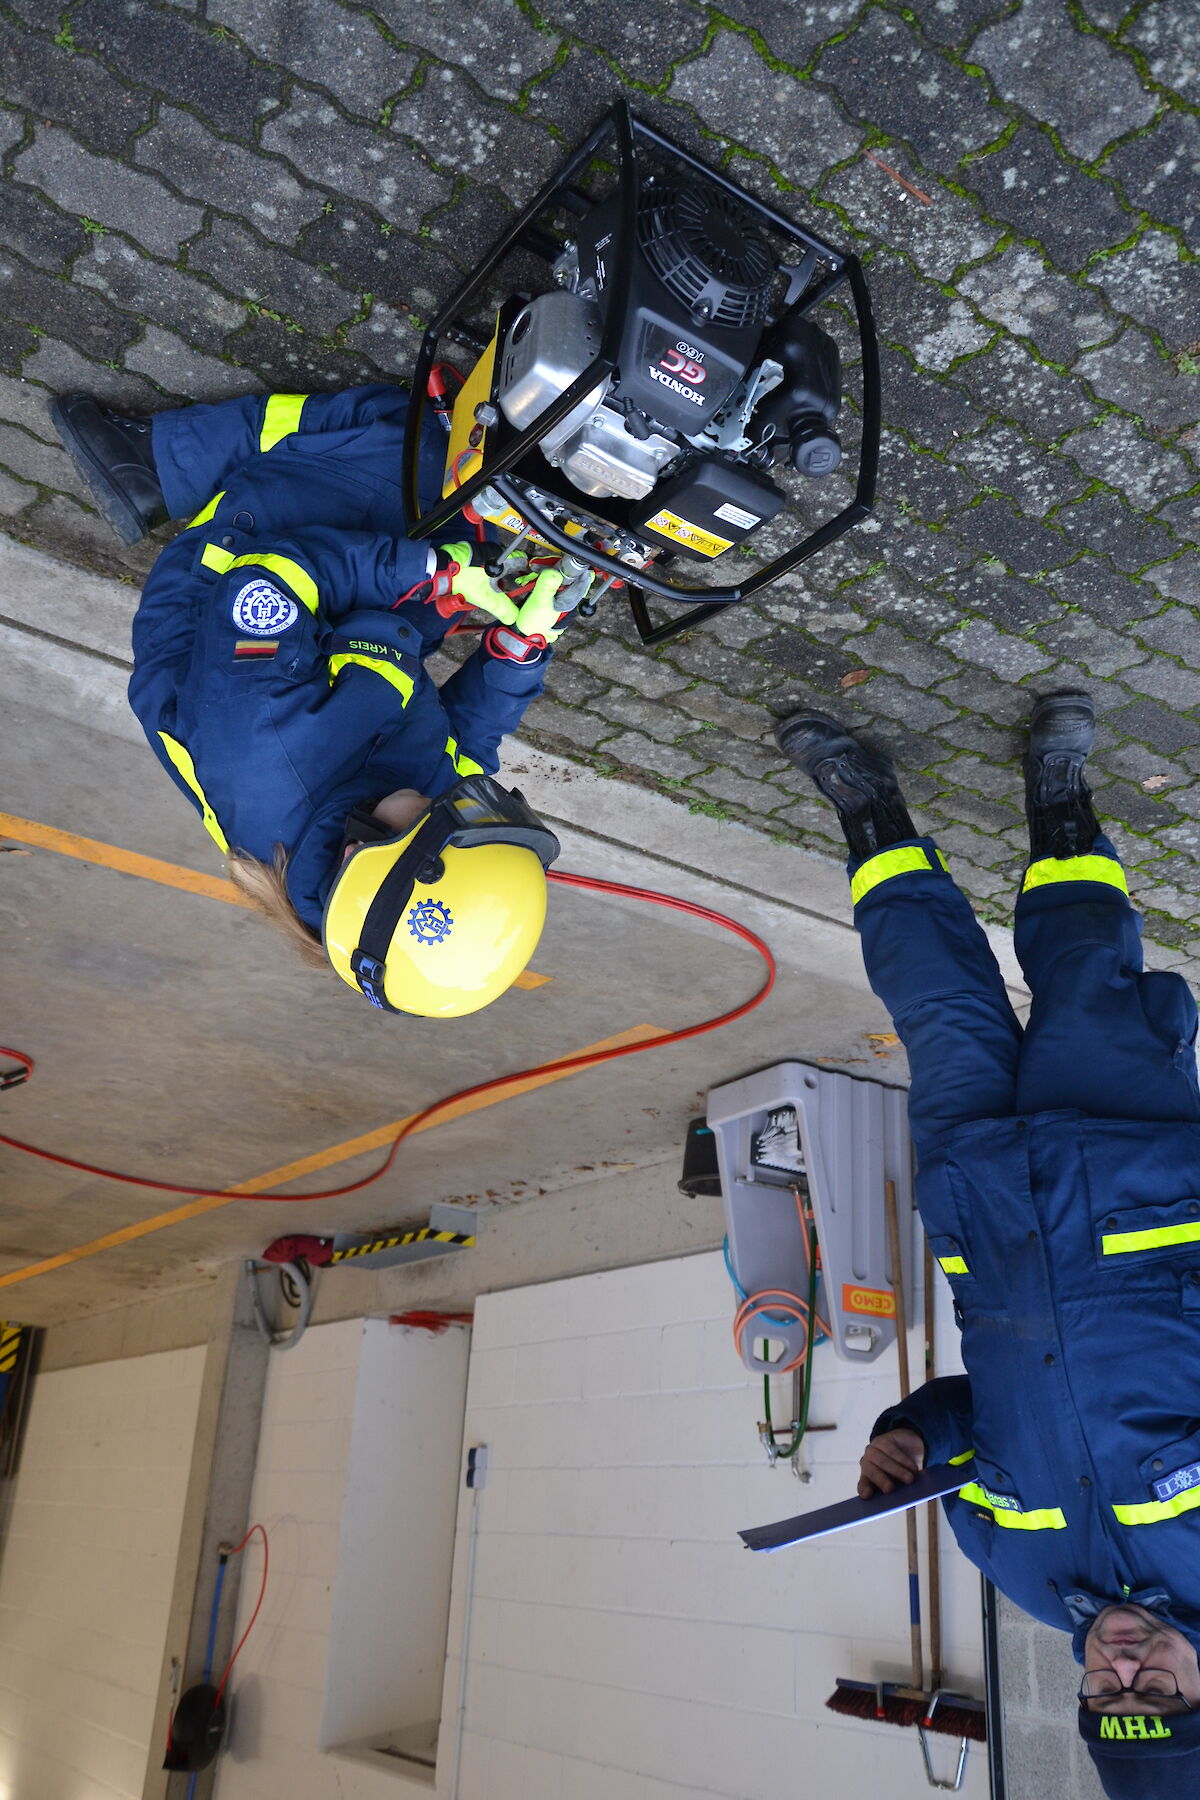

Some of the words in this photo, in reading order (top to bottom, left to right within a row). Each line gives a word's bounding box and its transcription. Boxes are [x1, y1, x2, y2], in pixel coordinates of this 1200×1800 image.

[676, 341, 705, 363] 160
[660, 349, 706, 384] GC
[648, 366, 706, 406] HONDA
[349, 640, 388, 655] KREIS
[391, 649, 402, 660] A.
[853, 1293, 892, 1311] CEMO
[1098, 1715, 1172, 1740] THW
